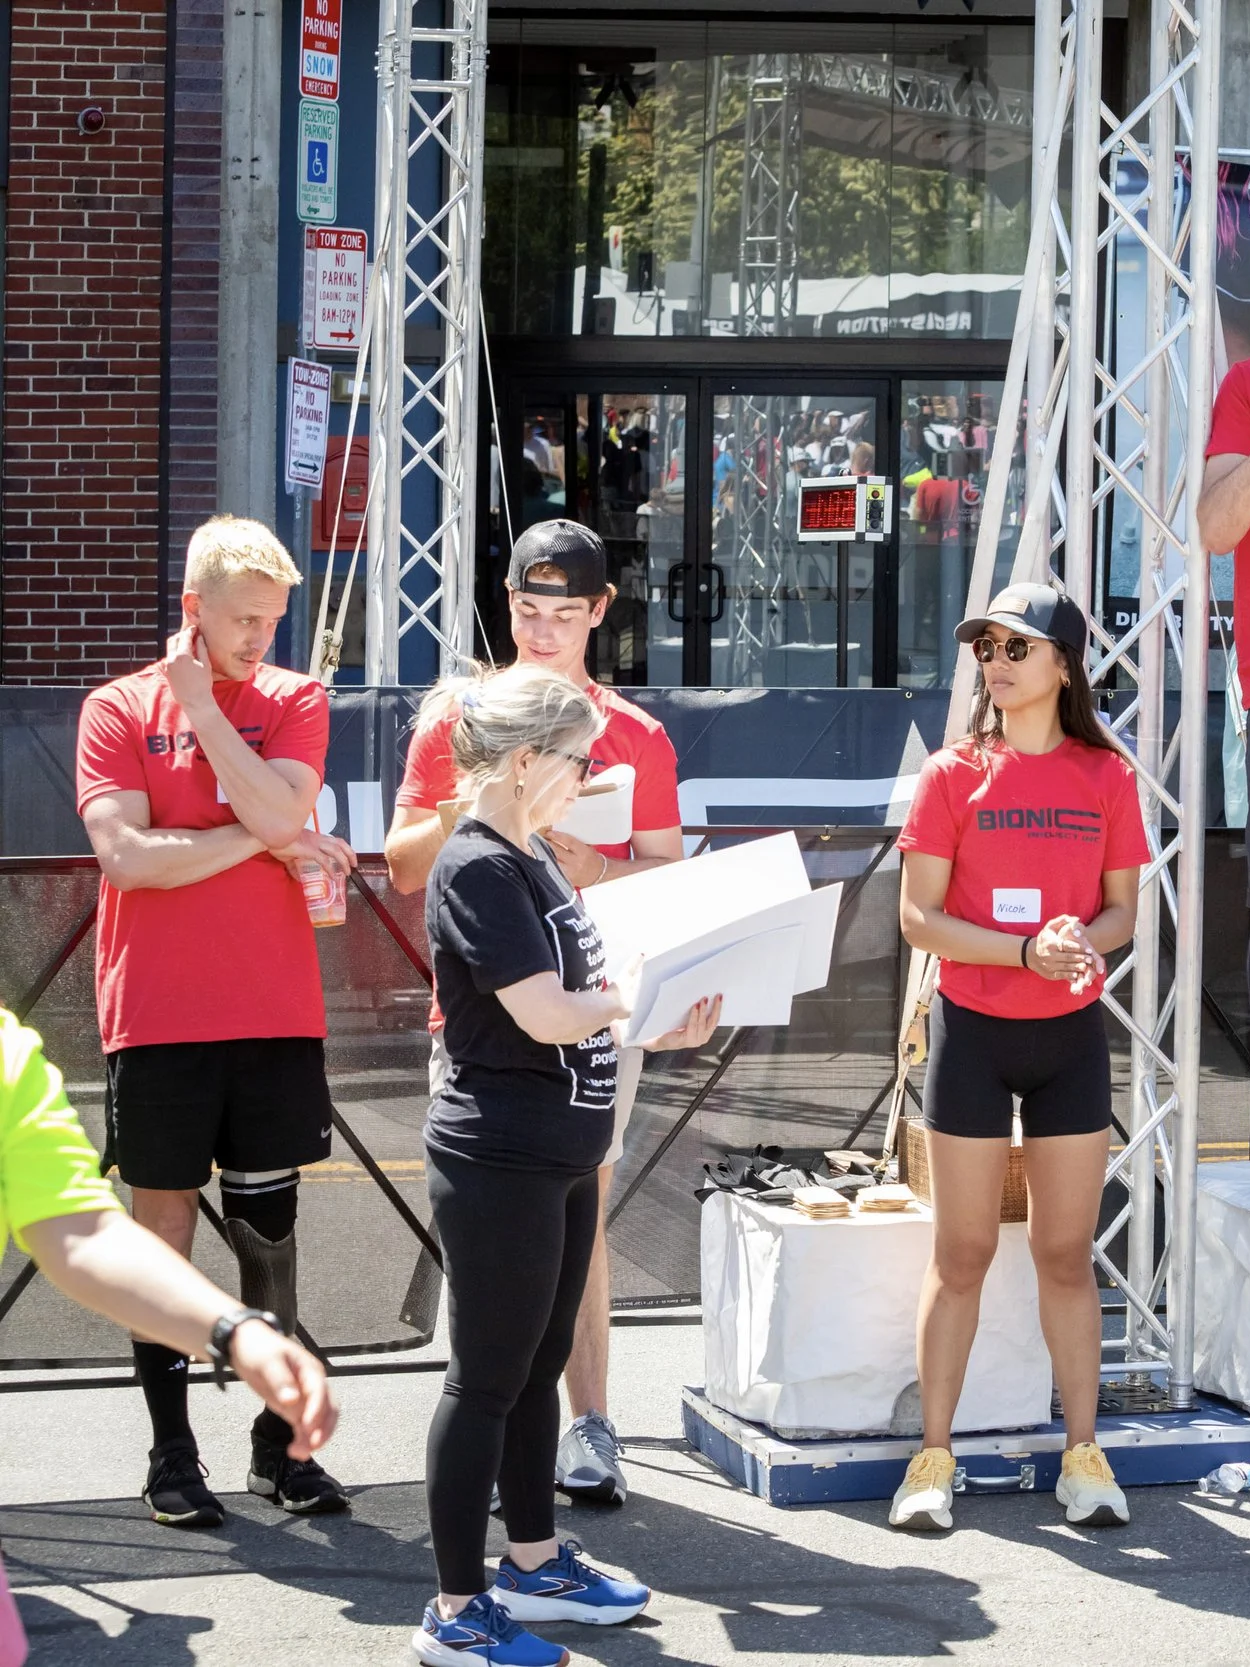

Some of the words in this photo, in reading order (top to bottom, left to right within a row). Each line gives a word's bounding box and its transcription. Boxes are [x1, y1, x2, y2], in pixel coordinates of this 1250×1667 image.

[316, 0, 328, 16] NO
[304, 16, 338, 39] PARKING
[306, 54, 334, 77] SNOW
[305, 80, 333, 95] EMERGENCY
[302, 106, 335, 125] RESERVED
[304, 123, 332, 140] PARKING
[320, 233, 337, 247] TOW
[341, 235, 362, 249] ZONE
[335, 253, 346, 267] NO
[322, 271, 357, 287] PARKING
[295, 365, 328, 387] TOW-ZONE
[305, 391, 315, 406] NO
[295, 405, 322, 424] PARKING
[977, 807, 1101, 832] BIONIC
[997, 903, 1027, 914] Nicole
